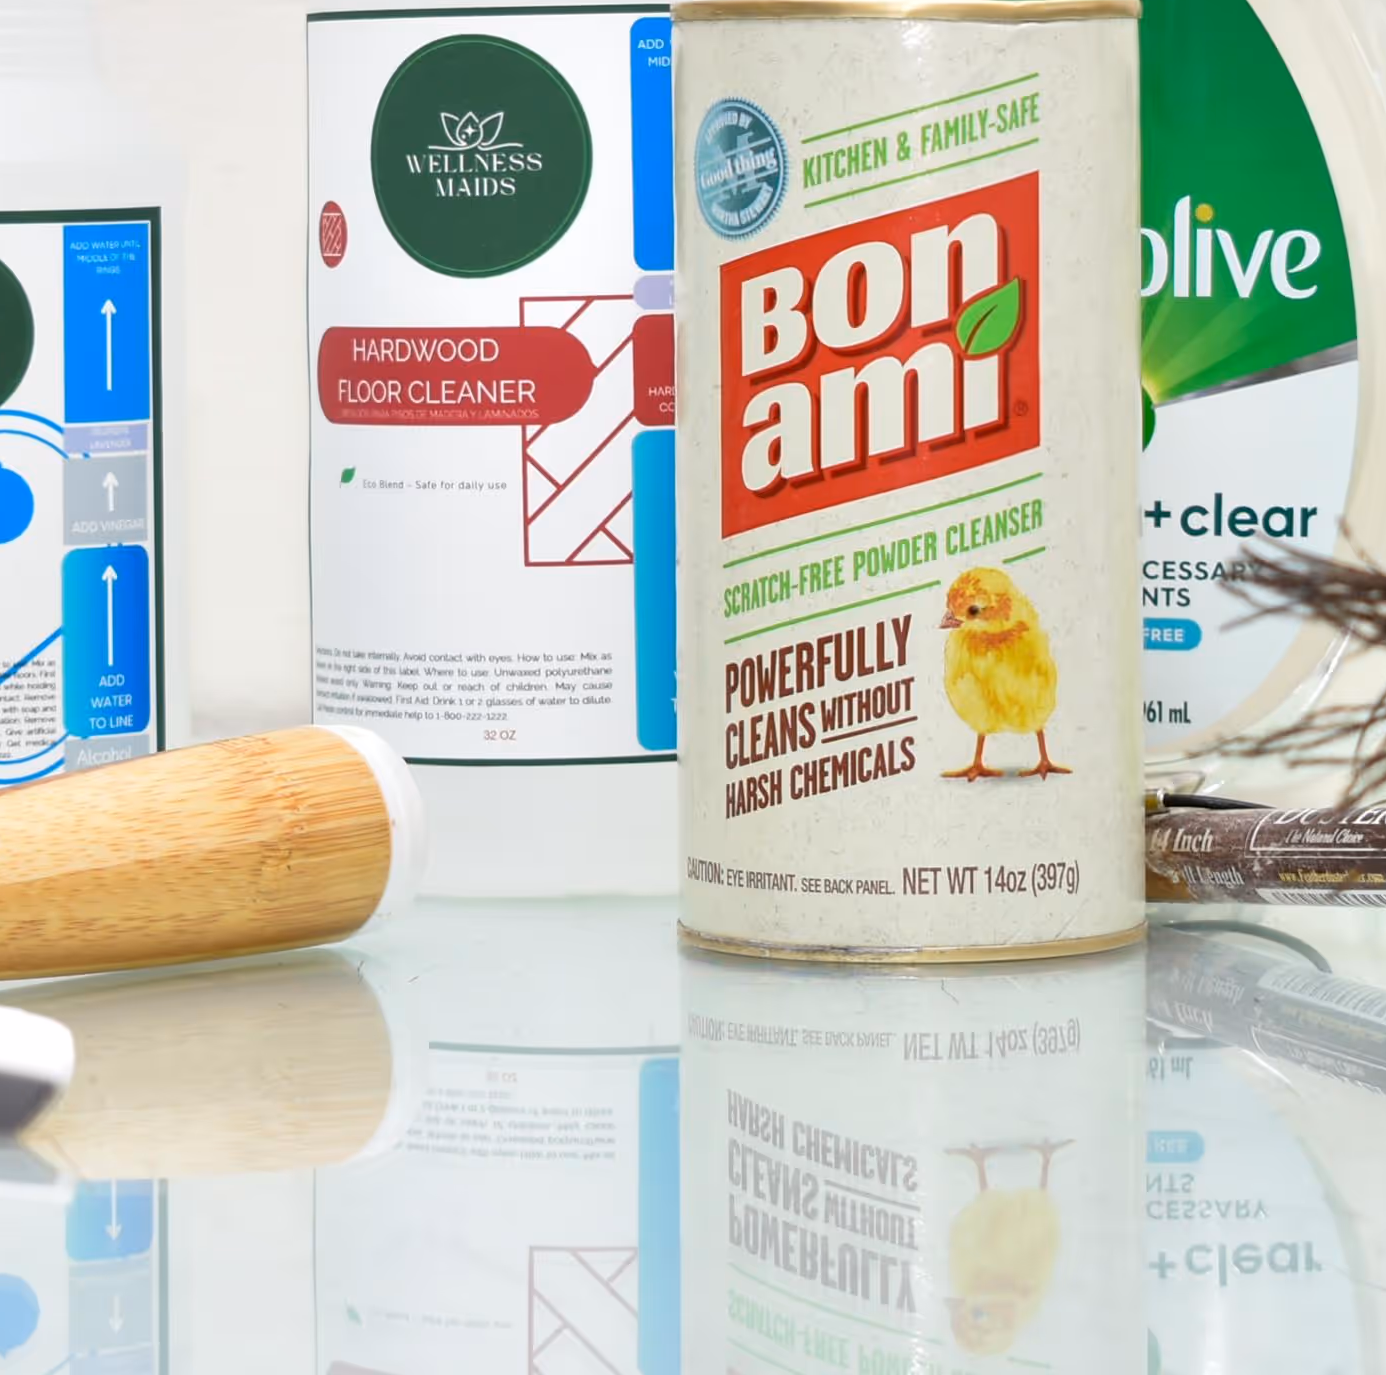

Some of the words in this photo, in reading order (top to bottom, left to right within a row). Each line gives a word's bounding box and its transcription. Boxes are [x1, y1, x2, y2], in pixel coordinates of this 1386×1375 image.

[637, 38, 664, 50] ADD
[802, 137, 888, 189] KITCHEN
[896, 131, 911, 162] &
[921, 92, 1040, 155] FAMILY-SAFE
[406, 152, 543, 175] WELLNESS
[734, 147, 778, 176] thing
[434, 176, 517, 198] MAIDS
[353, 338, 499, 362] HARDWOOD
[339, 379, 401, 403] FLOOR
[408, 379, 536, 404] CLEANER
[479, 409, 539, 419] LAMINADOS
[742, 341, 999, 492] ami
[363, 480, 377, 489] Eco
[379, 479, 404, 489] Blend
[416, 480, 437, 490] Safe
[440, 480, 454, 490] for
[458, 480, 484, 493] daily
[488, 483, 507, 491] use
[1180, 492, 1317, 538] clear
[724, 555, 845, 619] SCRATCH-FREE
[853, 531, 938, 582] POWDER
[946, 498, 1044, 555] CLEANSER
[403, 652, 426, 662] Avoid
[429, 653, 462, 662] contact
[466, 653, 486, 662] with
[517, 653, 540, 662] How
[543, 653, 553, 662] to
[580, 652, 597, 661] Mix
[600, 653, 612, 661] as
[725, 614, 912, 713] POWERFULLY
[98, 674, 125, 687] ADD
[423, 667, 454, 677] Where
[458, 668, 467, 677] to
[494, 668, 541, 677] Unwaxed
[545, 666, 613, 678] polyurethane
[397, 681, 418, 692] Keep
[443, 683, 452, 691] or
[458, 682, 485, 692] reach
[490, 682, 500, 692] of
[555, 682, 577, 693] May
[583, 681, 613, 690] cause
[90, 694, 132, 709] WATER
[395, 695, 412, 704] First
[432, 696, 456, 706] Drink
[465, 697, 475, 706] or
[486, 697, 523, 708] glasses
[526, 696, 535, 706] of
[538, 696, 566, 706] water
[569, 695, 580, 705] to
[1169, 701, 1191, 724] mL
[89, 716, 107, 729] TO
[110, 714, 134, 729] LINE
[405, 711, 423, 721] help
[425, 711, 433, 720] to
[725, 702, 816, 770] CLEANS
[820, 677, 914, 733] WITHOUT
[483, 729, 497, 741] 32
[499, 729, 517, 741] OZ
[77, 745, 132, 766] Alcohol
[725, 769, 783, 819] HARSH
[790, 736, 915, 801] CHEMICALS
[1173, 828, 1213, 852] Inch
[1336, 828, 1364, 844] Choice
[687, 856, 724, 885] CAUTION:
[726, 869, 744, 887] EYE
[746, 871, 797, 892] IRRITANT.
[801, 878, 822, 893] SEE
[824, 879, 854, 894] BACK
[856, 880, 896, 895] PANEL.
[903, 867, 941, 895] NET
[946, 867, 978, 894] WT
[983, 867, 1026, 894] 14oz
[1031, 860, 1080, 897] (397g)
